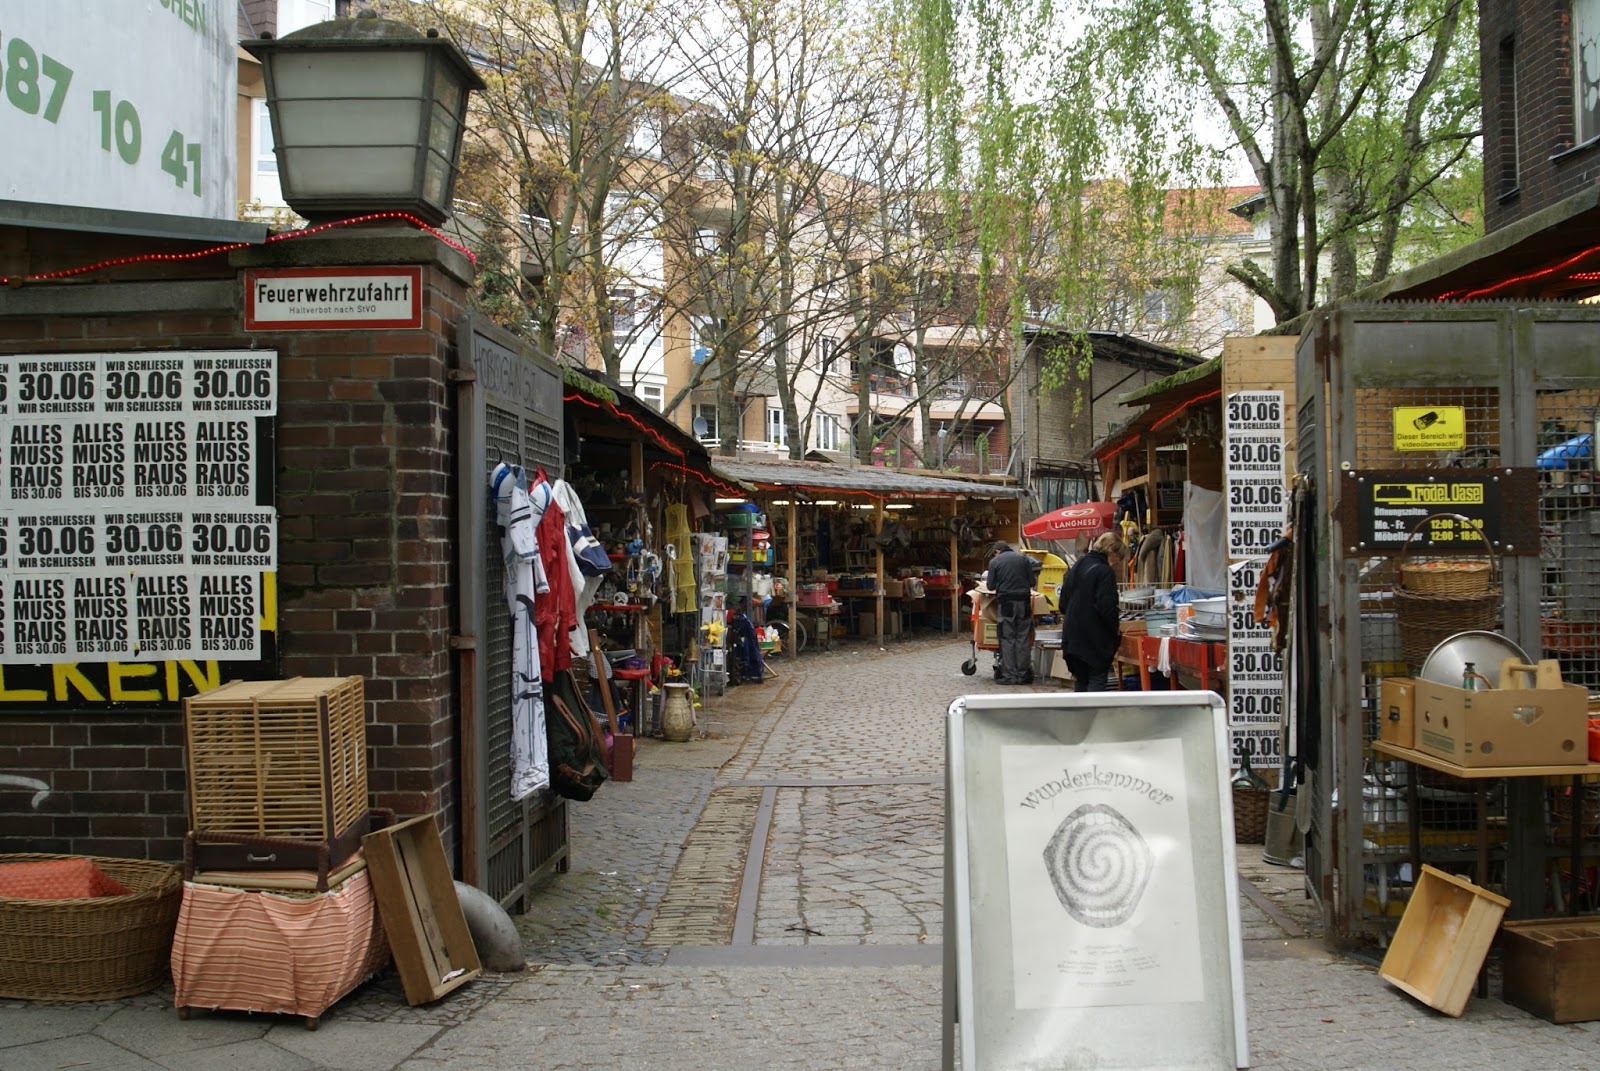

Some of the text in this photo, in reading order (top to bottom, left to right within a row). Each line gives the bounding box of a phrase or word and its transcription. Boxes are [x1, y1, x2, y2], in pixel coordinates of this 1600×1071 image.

[0, 30, 202, 198] 87 10 41
[258, 282, 409, 303] Feuerwehrzufahrt
[289, 306, 332, 314] Haltverbot
[357, 305, 376, 313] StVO
[19, 361, 95, 372] WIR SCHLIESSEN
[106, 360, 183, 371] WIR SCHLIESSEN
[194, 359, 271, 369] WIR SCHLIESSEN
[20, 373, 94, 401] 30.06
[107, 371, 181, 399] 30.06
[194, 370, 270, 398] 30.06
[18, 402, 94, 413] WIR SCHLIESSEN
[105, 401, 182, 411] WIR SCHLIESSEN
[193, 400, 271, 410] WIR SCHLIESSEN
[1229, 403, 1279, 421] 30.06
[11, 425, 62, 444] ALLES
[73, 423, 123, 443] ALLES
[135, 422, 185, 441] ALLES
[196, 422, 248, 441] ALLES
[11, 446, 63, 465] MUSS
[73, 444, 124, 464] MUSS
[135, 443, 187, 463] MUSS
[196, 443, 250, 462] MUSS
[1230, 445, 1280, 462] 30.06
[11, 466, 62, 487] RAUS
[73, 465, 124, 486] RAUS
[135, 464, 186, 485] RAUS
[196, 464, 249, 484] RAUS
[12, 488, 61, 499] BIS 30.06
[74, 486, 124, 497] BIS 30.06
[136, 485, 186, 497] BIS 30.06
[197, 485, 249, 496] BIS 30.06
[1231, 487, 1281, 504] 30.06
[1452, 484, 1480, 501] Oase
[18, 515, 95, 526] WIR SCHLIESSEN
[105, 513, 182, 524] WIR SCHLIESSEN
[192, 513, 271, 523] WIR SCHLIESSEN
[1055, 519, 1096, 528] LANGNESE
[1430, 520, 1454, 529] 12:00
[19, 527, 94, 555] 30.06
[106, 524, 182, 553] 30.06
[193, 525, 270, 553] 30.06
[1232, 528, 1282, 546] 30.06
[1430, 531, 1454, 540] 12:00
[19, 557, 95, 567] WIR SCHLIESSEN
[106, 554, 183, 566] WIR SCHLIESSEN
[192, 555, 270, 565] WIR SCHLIESSEN
[14, 579, 64, 599] ALLES
[75, 577, 125, 597] ALLES
[137, 576, 188, 597] ALLES
[200, 576, 252, 595] ALLES
[14, 600, 66, 620] MUSS
[75, 599, 127, 618] MUSS
[137, 597, 190, 617] MUSS
[200, 597, 254, 616] MUSS
[14, 621, 66, 643] RAUS
[75, 619, 128, 640] RAUS
[138, 618, 191, 639] RAUS
[200, 618, 254, 638] RAUS
[16, 643, 66, 654] BIS 30.06
[77, 641, 127, 652] BIS 30.06
[140, 639, 191, 651] BIS 30.06
[202, 639, 253, 650] BIS 30.06
[1233, 654, 1282, 672] 30.06
[1233, 696, 1281, 714] 30.06
[1233, 738, 1280, 756] 30.06
